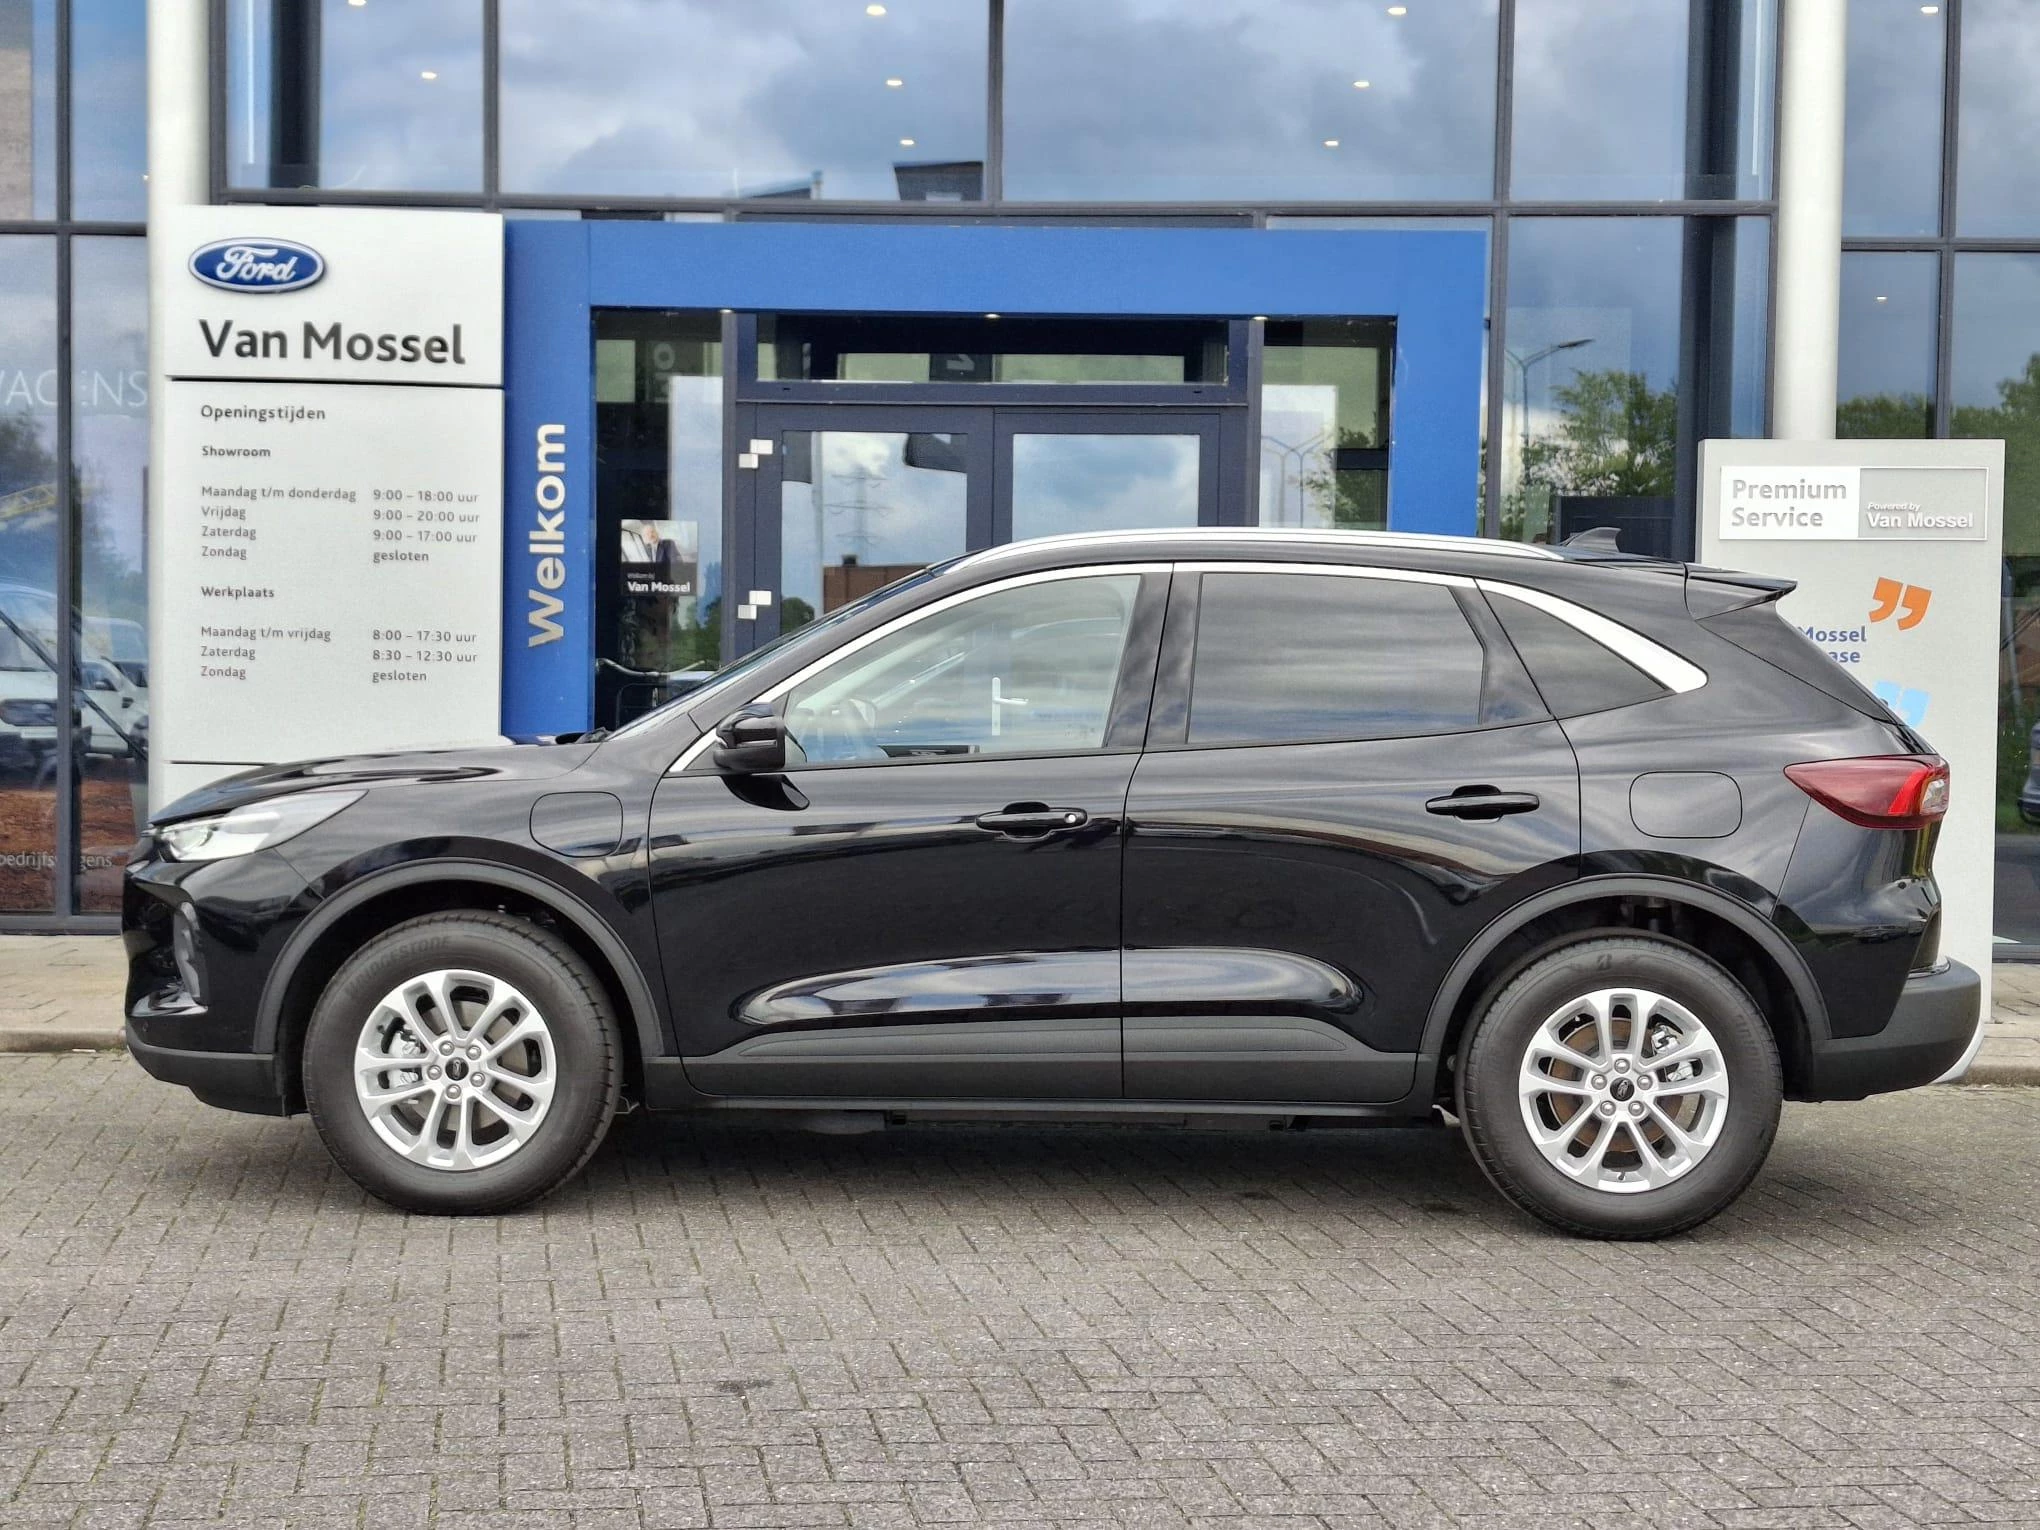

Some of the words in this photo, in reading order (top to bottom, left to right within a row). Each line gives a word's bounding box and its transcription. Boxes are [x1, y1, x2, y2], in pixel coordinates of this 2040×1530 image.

[216, 246, 299, 281] Ford
[199, 319, 288, 358] Van
[303, 321, 466, 365] Mossel
[200, 404, 327, 422] Openingstijden
[202, 446, 271, 458] Showroom
[201, 485, 257, 501] Maandag
[261, 486, 284, 498] t/m
[288, 488, 357, 502] donderdag
[373, 489, 403, 500] 9:00
[418, 490, 453, 502] 18:00
[457, 493, 479, 502] uur
[1732, 478, 1848, 500] Premium
[201, 506, 246, 520] Vrijdag
[373, 509, 403, 521] 9:00
[417, 511, 455, 522] 20:00
[458, 513, 480, 523] uur
[1868, 502, 1907, 511] Powered
[1909, 502, 1921, 512] by
[1731, 506, 1824, 528] Service
[1867, 512, 1902, 528] Van
[1907, 512, 1974, 528] Mossel
[201, 525, 257, 540] Zaterdag
[373, 530, 403, 541] 9:00
[417, 531, 453, 542] 17:00
[456, 533, 478, 543] uur
[528, 424, 566, 648] Welkom
[201, 546, 247, 560] Zondag
[373, 550, 430, 563] gesloten
[201, 586, 275, 600] Werkplaats
[627, 581, 649, 592] Van
[651, 580, 691, 592] Mossel
[201, 626, 257, 641] Maandag
[260, 627, 284, 639] t/m
[287, 628, 332, 642] vrijdag
[372, 629, 402, 641] 8:00
[416, 630, 452, 642] 17:30
[455, 633, 477, 643] uur
[201, 646, 256, 660] Zaterdag
[372, 649, 402, 661] 8:30
[416, 651, 453, 662] 12:30
[456, 653, 478, 663] uur
[200, 666, 247, 680] Zondag
[372, 670, 428, 683] gesloten
